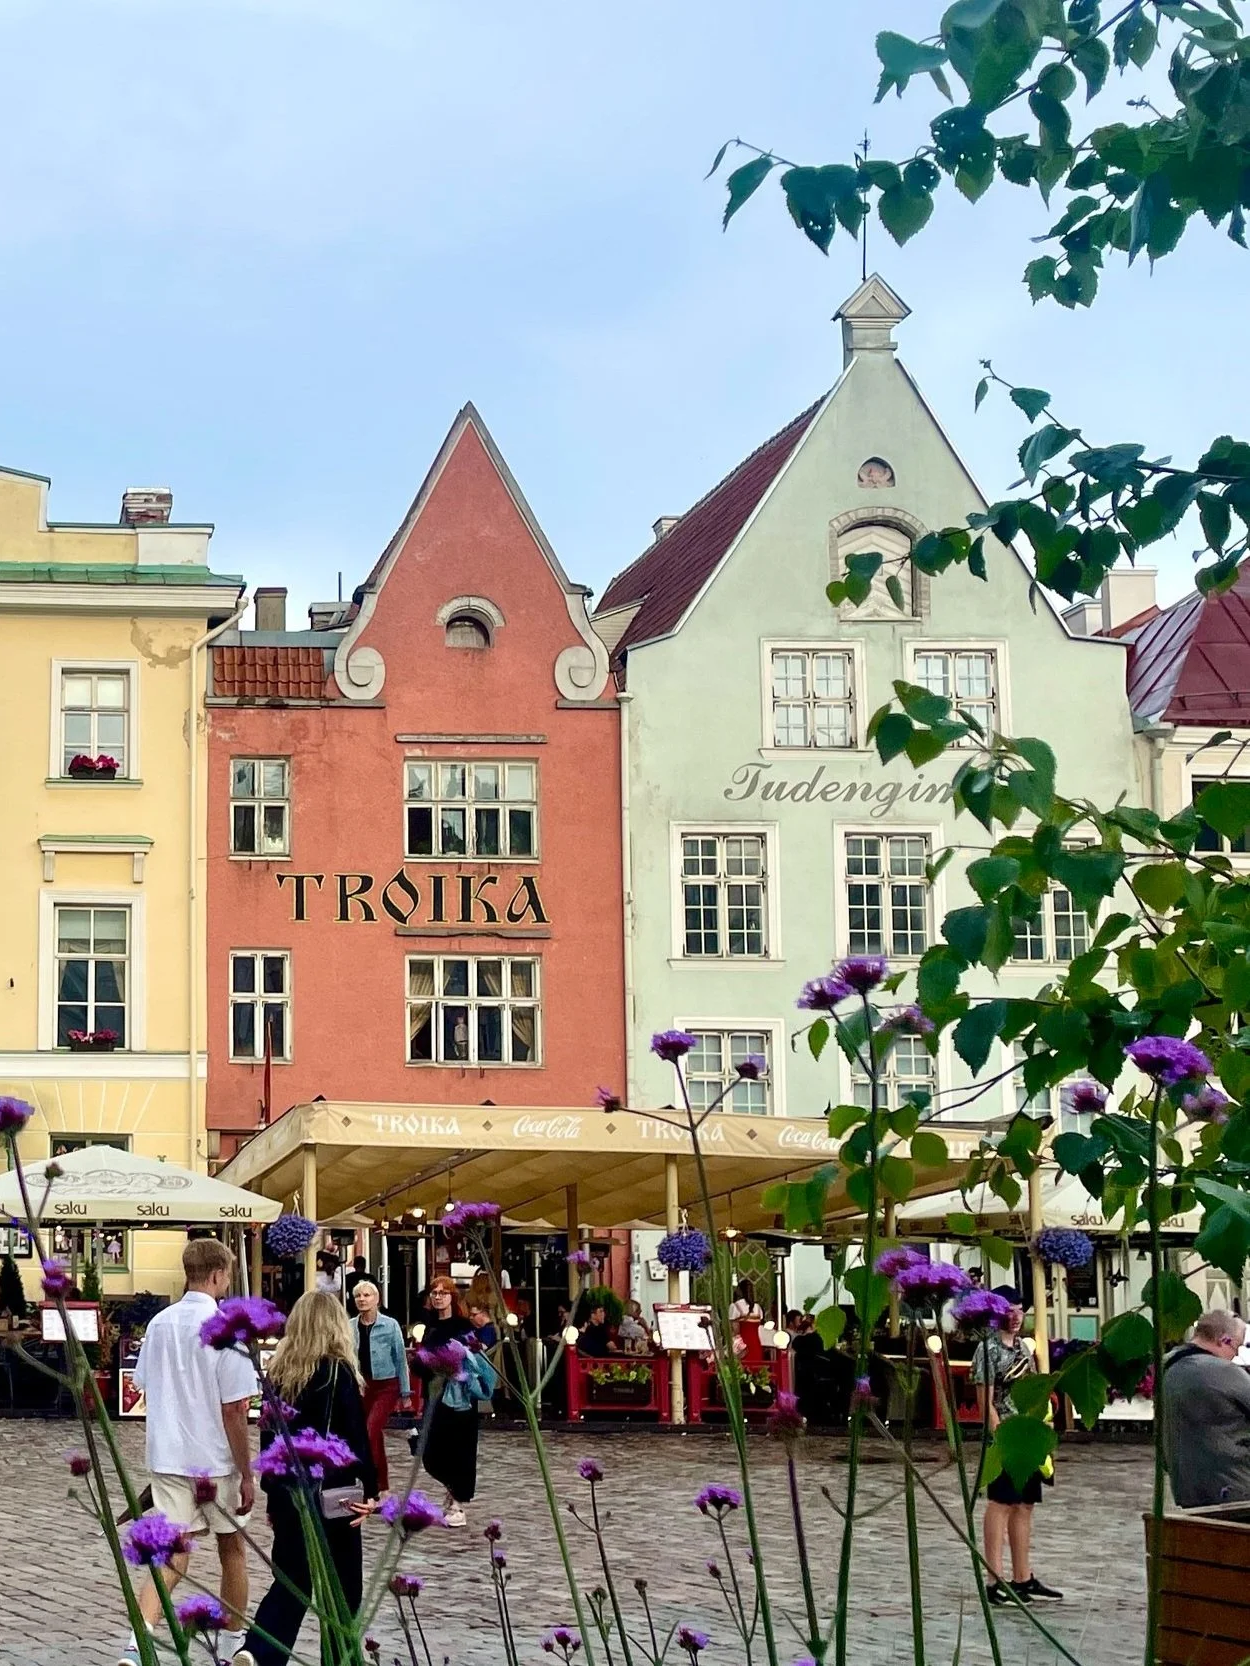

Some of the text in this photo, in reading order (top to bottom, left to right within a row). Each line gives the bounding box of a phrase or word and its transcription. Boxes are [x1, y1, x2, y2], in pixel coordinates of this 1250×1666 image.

[275, 866, 552, 926] TROIKA
[370, 1111, 462, 1136] TROIKA
[54, 1201, 87, 1215] saku
[137, 1202, 170, 1217] saku
[219, 1203, 252, 1218] saku
